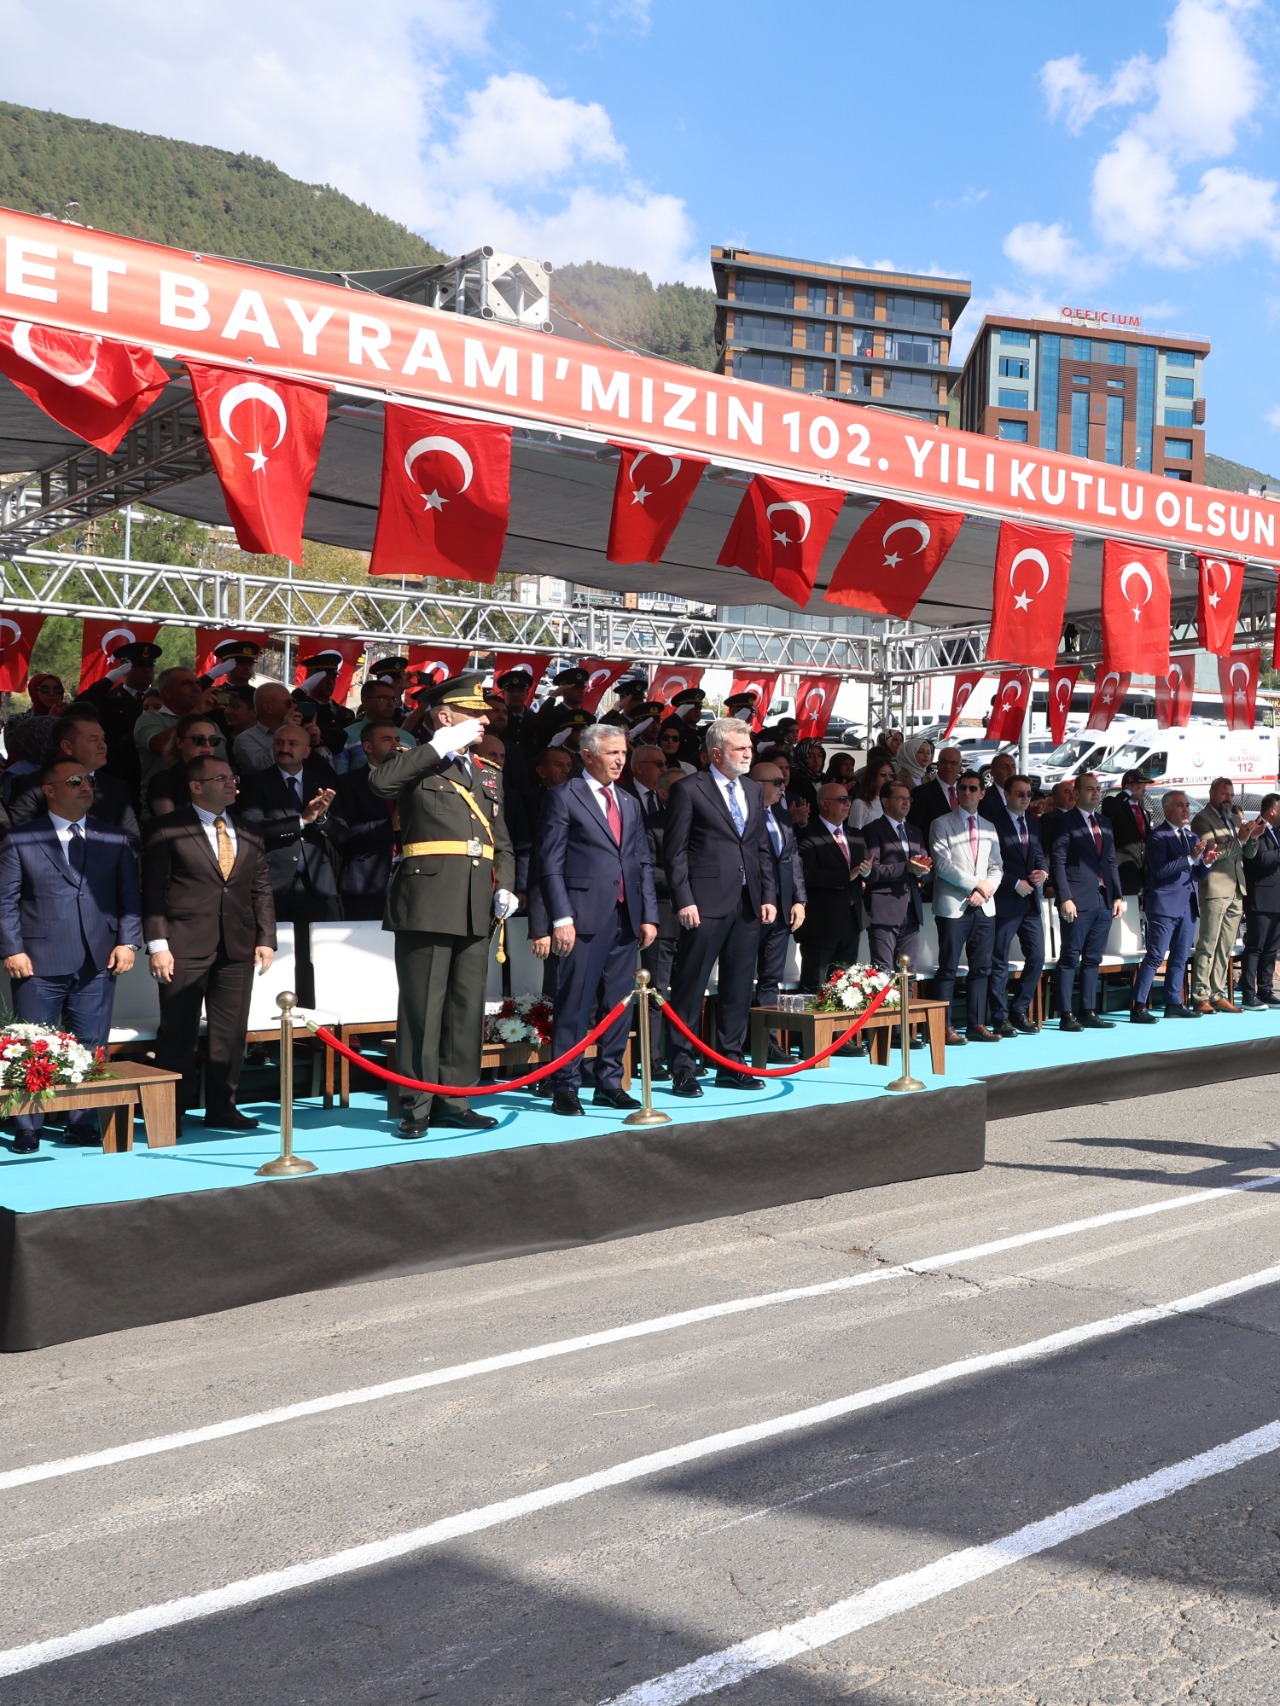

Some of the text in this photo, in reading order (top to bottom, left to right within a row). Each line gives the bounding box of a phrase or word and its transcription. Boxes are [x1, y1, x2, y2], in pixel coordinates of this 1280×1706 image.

[1061, 306, 1140, 326] OFFICIUM
[5, 235, 127, 314] ET
[782, 410, 889, 472] 102.
[903, 434, 995, 492] YILI
[1010, 458, 1144, 521] KUTLU
[1155, 491, 1275, 547] OLSUN
[1237, 762, 1254, 773] 112
